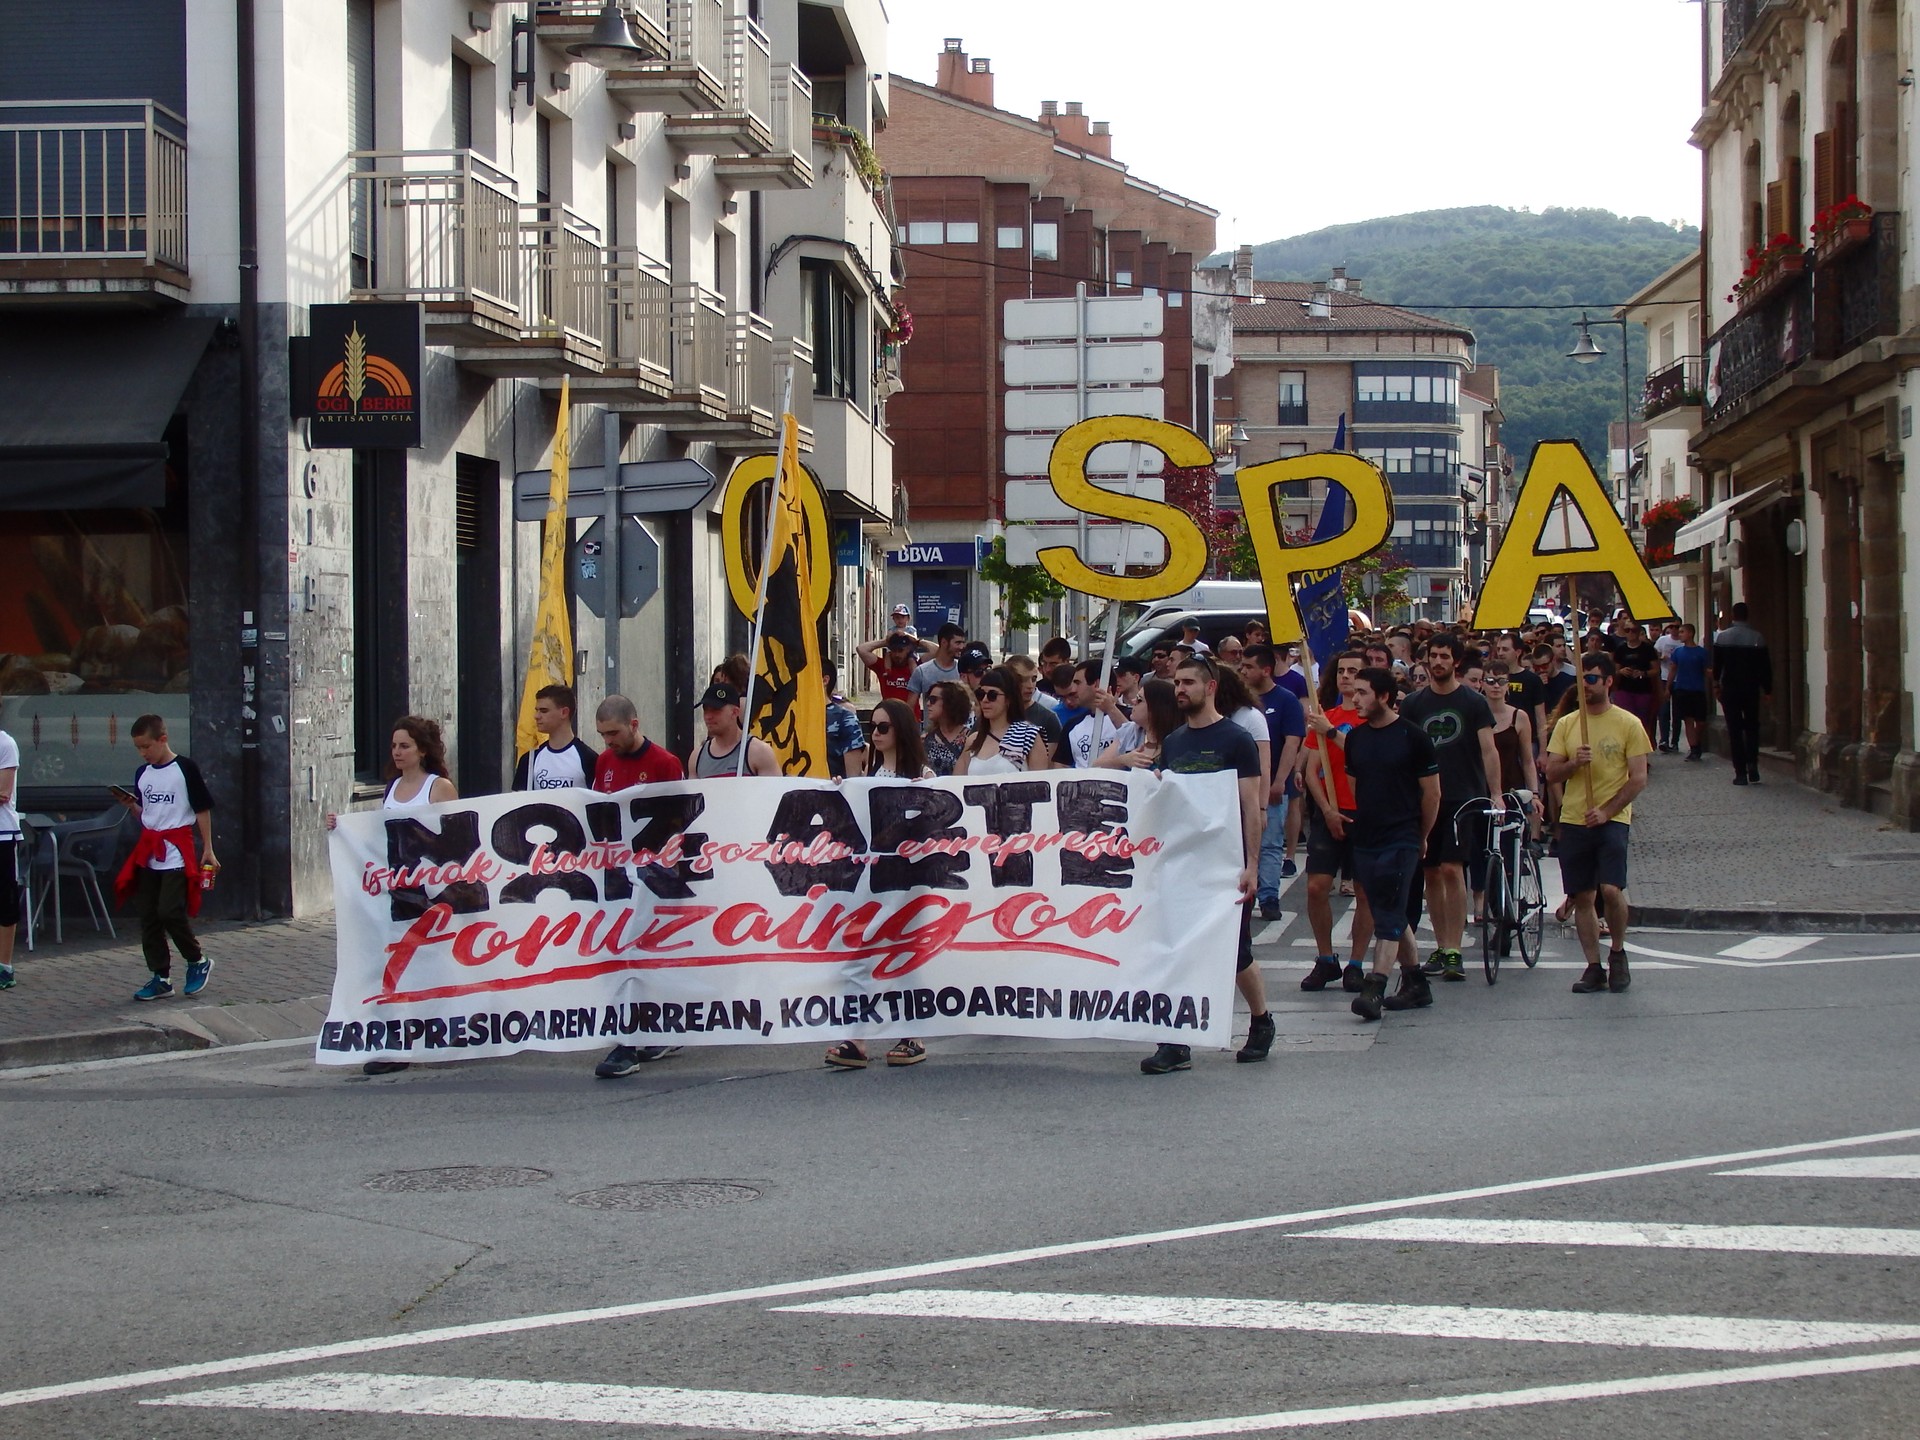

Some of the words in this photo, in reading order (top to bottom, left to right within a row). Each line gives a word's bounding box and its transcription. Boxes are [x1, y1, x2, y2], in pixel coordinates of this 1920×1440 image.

[316, 397, 349, 411] OGI
[362, 397, 413, 411] BERRI
[319, 415, 374, 423] ARTISAU
[897, 547, 943, 562] BBVA
[766, 779, 1135, 897] ARTE
[320, 1007, 597, 1052] ERREPRESIOAREN
[600, 999, 774, 1037] AURREAN,
[780, 986, 1062, 1029] KOLEKTIBOAREN
[1069, 990, 1210, 1032] INDARRA!
